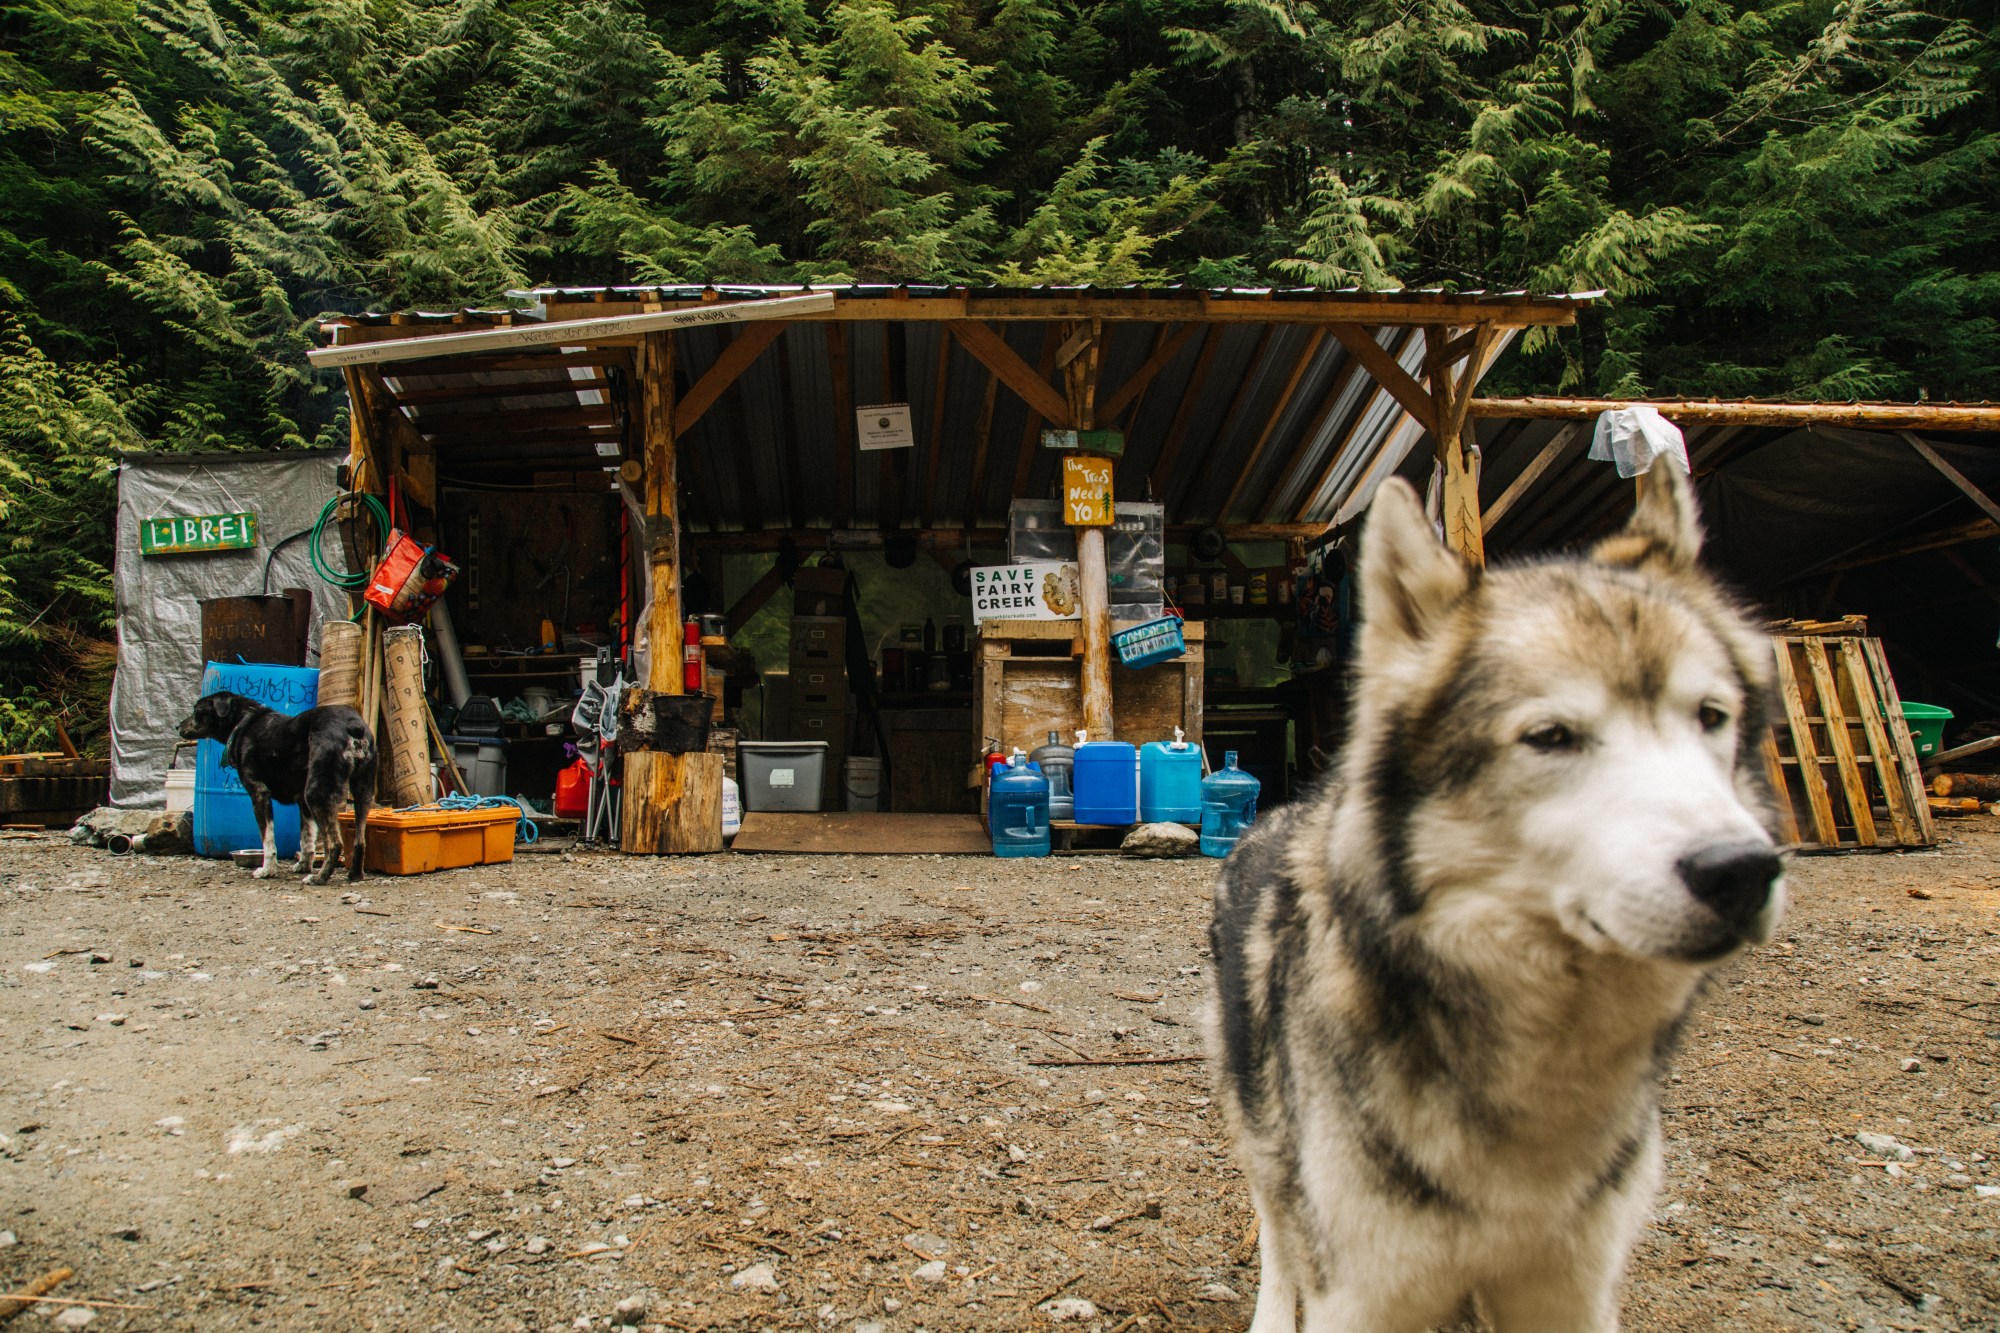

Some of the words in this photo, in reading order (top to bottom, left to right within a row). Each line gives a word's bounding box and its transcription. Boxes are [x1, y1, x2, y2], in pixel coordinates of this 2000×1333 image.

[1066, 459, 1084, 472] The
[1070, 485, 1103, 500] Need
[975, 569, 1034, 583] SAVE
[976, 582, 1034, 597] FAIRY
[977, 596, 1036, 610] CREEK
[207, 623, 267, 640] AUTION
